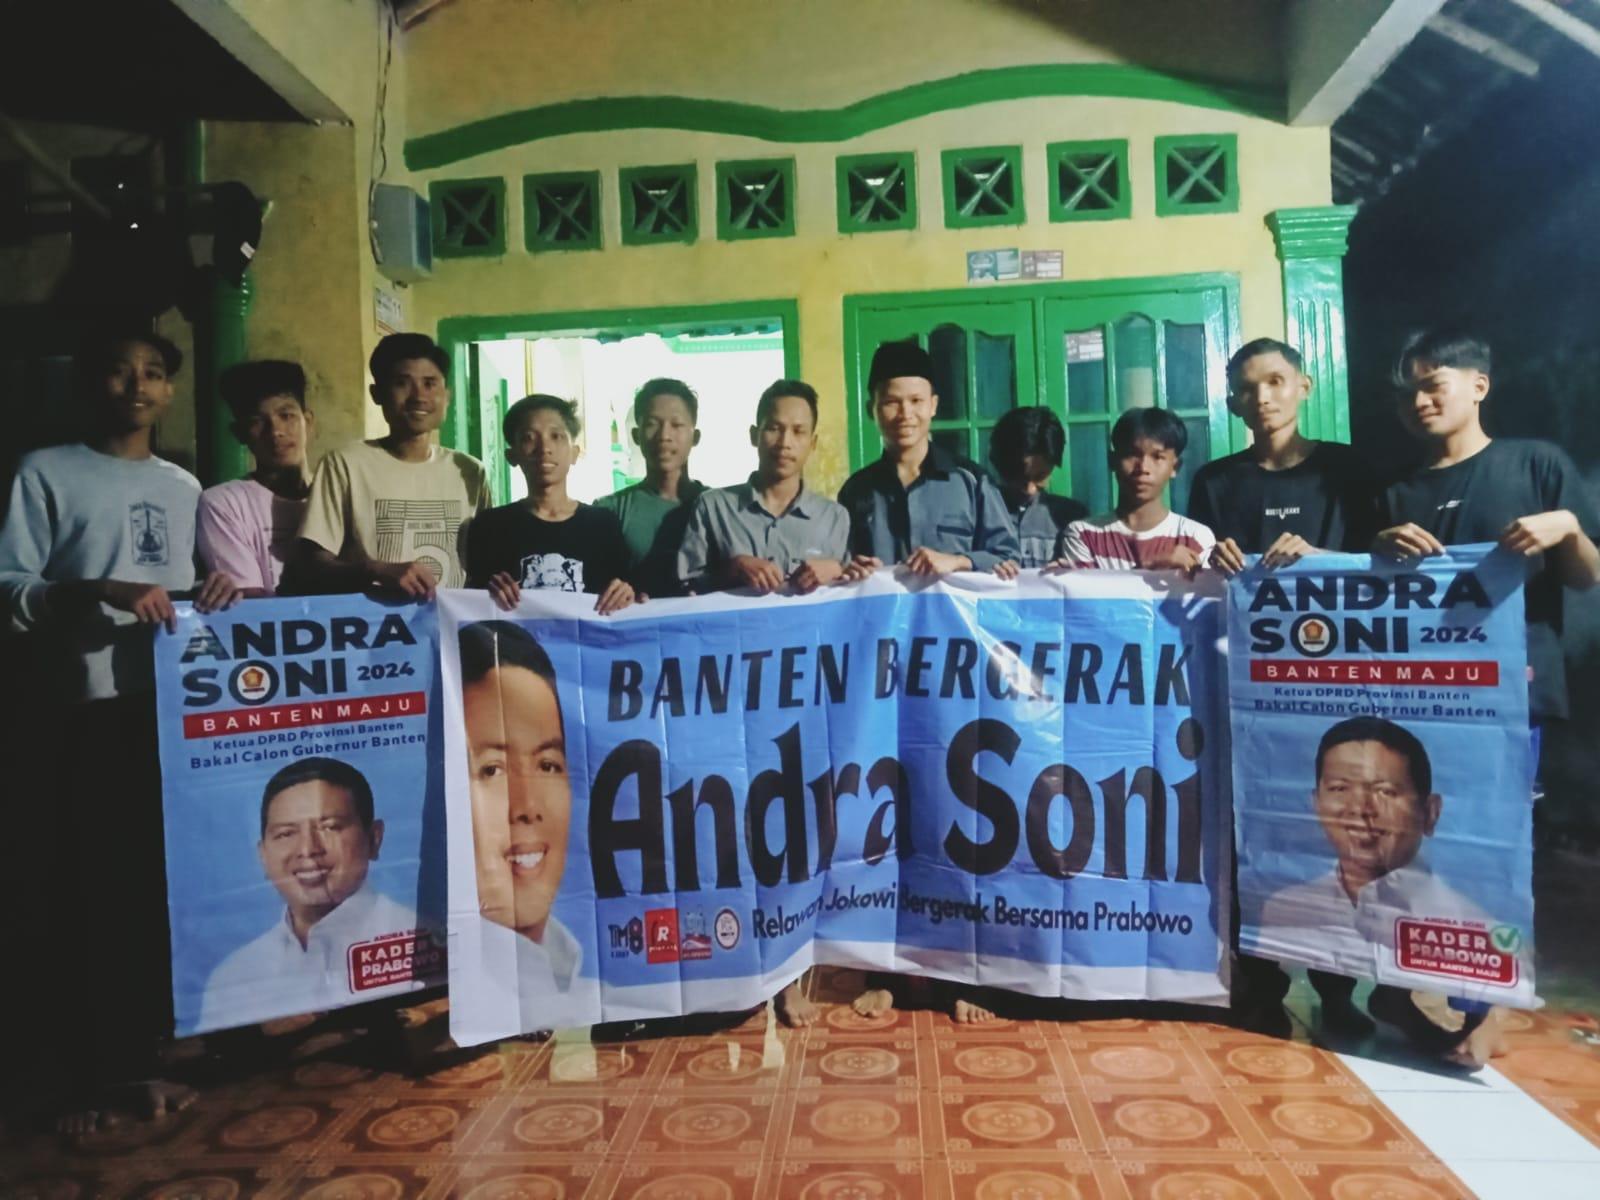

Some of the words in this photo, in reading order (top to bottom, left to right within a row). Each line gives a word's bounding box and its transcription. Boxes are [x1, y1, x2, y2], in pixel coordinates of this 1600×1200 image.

[1249, 571, 1492, 612] ANDRA
[180, 614, 417, 663] ANDRA
[1250, 613, 1409, 658] SONI
[1420, 626, 1487, 643] 2024
[182, 658, 347, 707] SONI
[357, 660, 415, 681] 2024
[608, 642, 849, 722] BANTEN
[875, 636, 1193, 706] BERGERAK
[1267, 666, 1381, 680] BANTEN
[1397, 666, 1479, 681] MAJU
[1255, 699, 1298, 711] Bakal
[1302, 700, 1344, 714] Calon
[1349, 701, 1427, 716] Gubernur
[1432, 704, 1496, 718] Banten
[1274, 687, 1312, 698] Ketua
[1316, 687, 1355, 698] DPRD
[1358, 688, 1414, 700] Provinsi
[1419, 689, 1470, 701] Banten
[203, 705, 323, 732] BANTEN
[337, 699, 411, 718] MAJU
[191, 754, 238, 769] Bakal
[242, 748, 289, 763] Calon
[293, 741, 367, 757] Gubernur
[372, 733, 426, 748] Banten
[213, 738, 255, 751] Ketua
[258, 732, 297, 747] DPRD
[301, 725, 355, 741] Provinsi
[358, 721, 404, 735] Banten
[588, 721, 914, 899] Andra
[943, 717, 1205, 885] Soni
[752, 895, 823, 938] Relawan
[825, 882, 896, 910] Jokowi
[900, 883, 989, 925] Bergerak
[995, 895, 1089, 931] Bersama
[1094, 900, 1193, 935] Prabowo
[1409, 928, 1487, 950] KADER
[1410, 943, 1502, 968] PRABOWO
